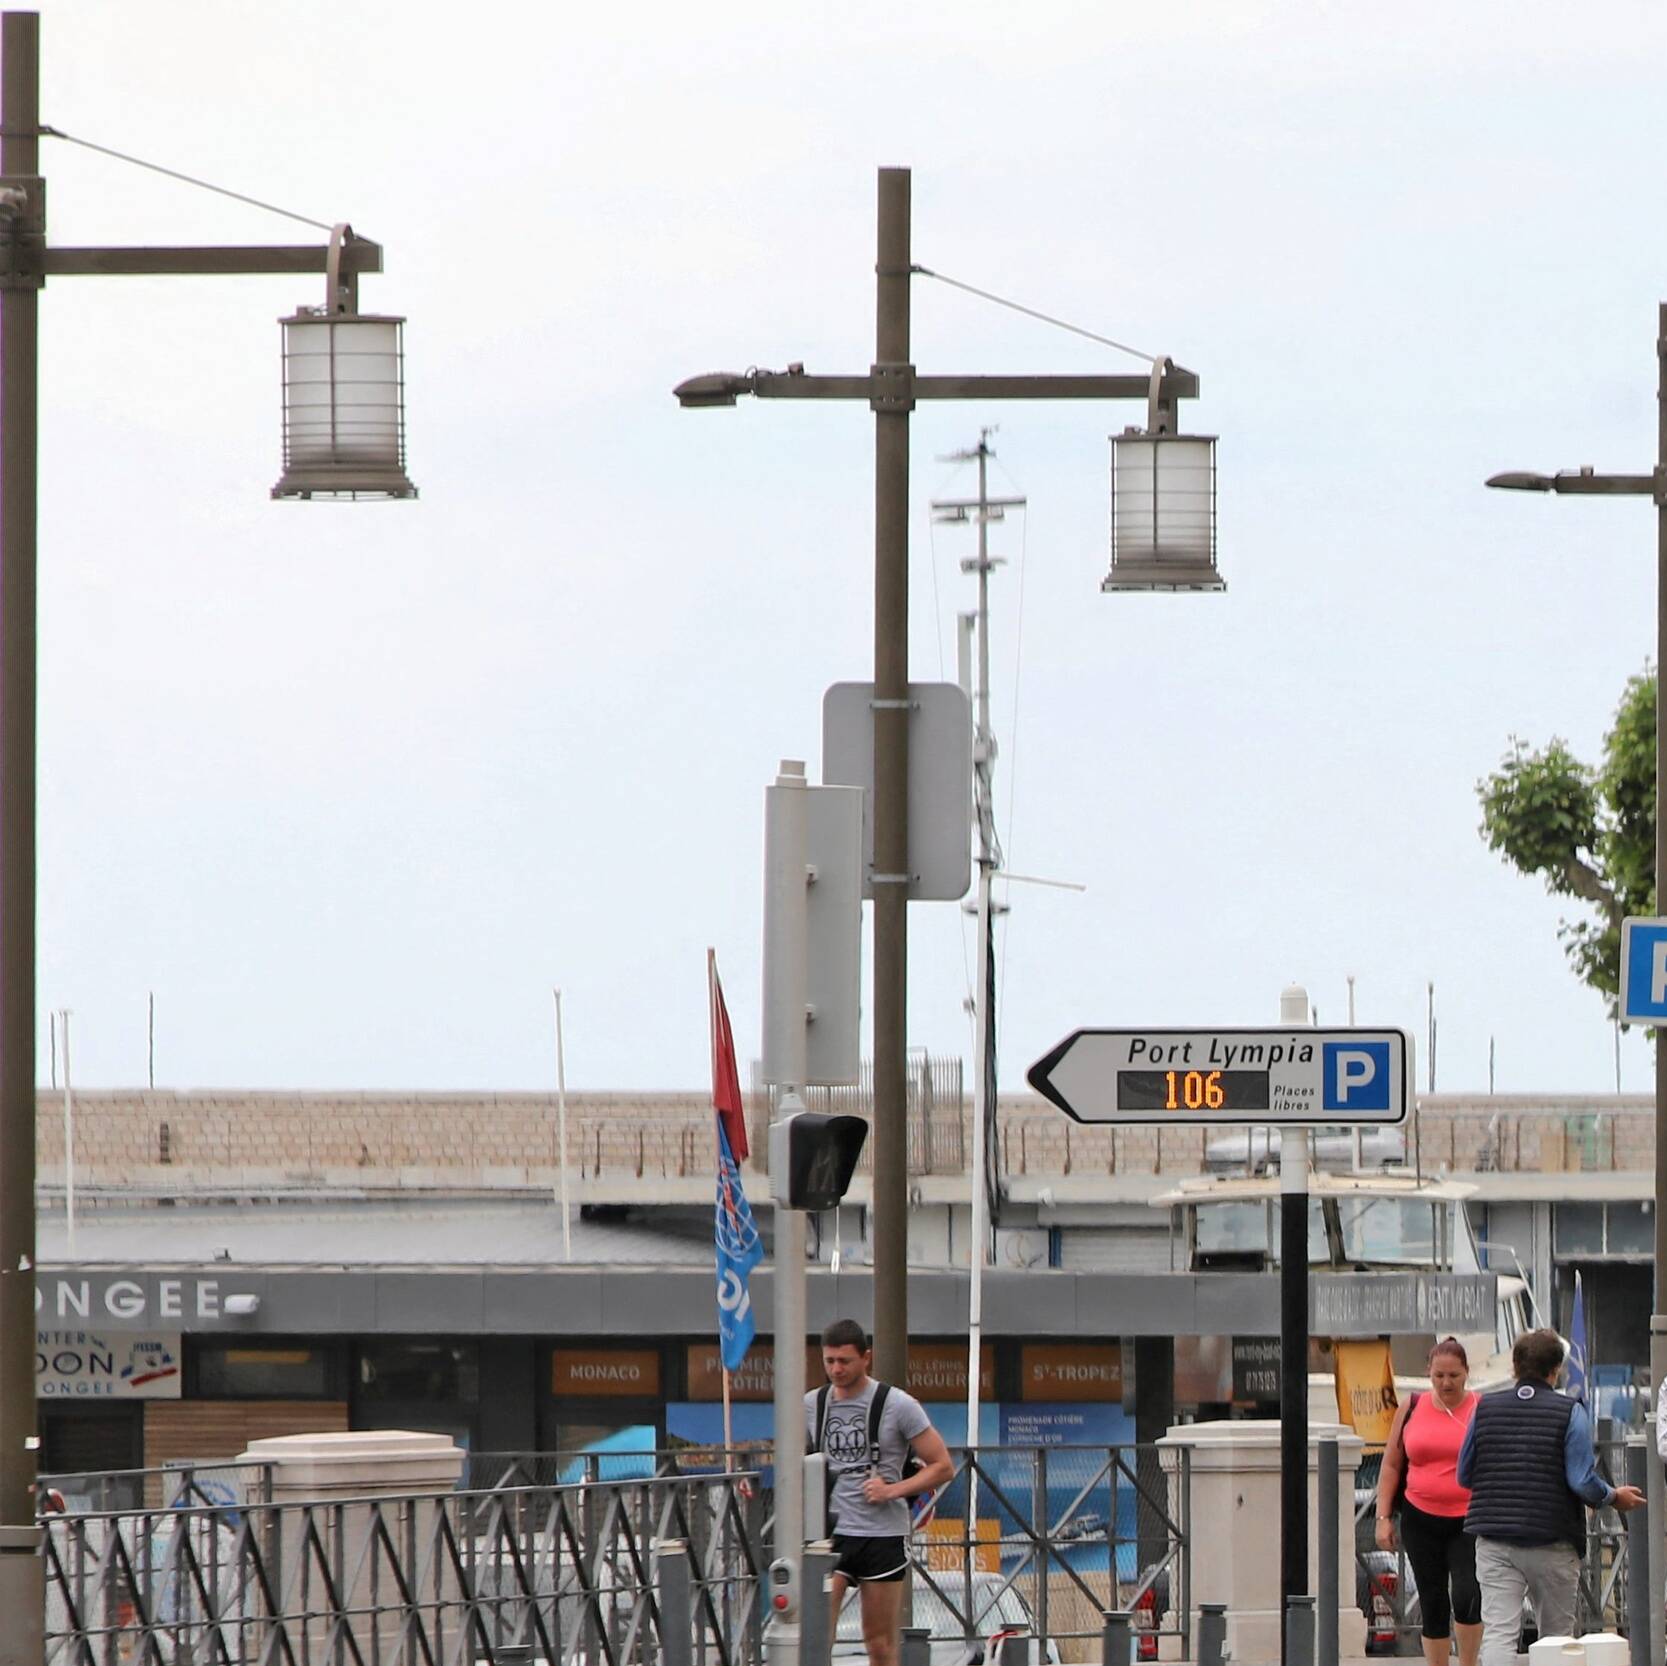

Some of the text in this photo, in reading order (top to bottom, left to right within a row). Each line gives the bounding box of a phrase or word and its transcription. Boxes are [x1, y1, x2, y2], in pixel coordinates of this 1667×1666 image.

[1127, 1038, 1314, 1070] Port Lympia
[1336, 1051, 1376, 1103] P
[1165, 1071, 1224, 1110] 106
[1274, 1085, 1315, 1097] Places
[1274, 1099, 1310, 1111] libres
[36, 1279, 219, 1319] NGEE
[37, 1330, 86, 1345] NTER
[570, 1364, 640, 1381] MONACO
[43, 1382, 113, 1395] ONGEE
